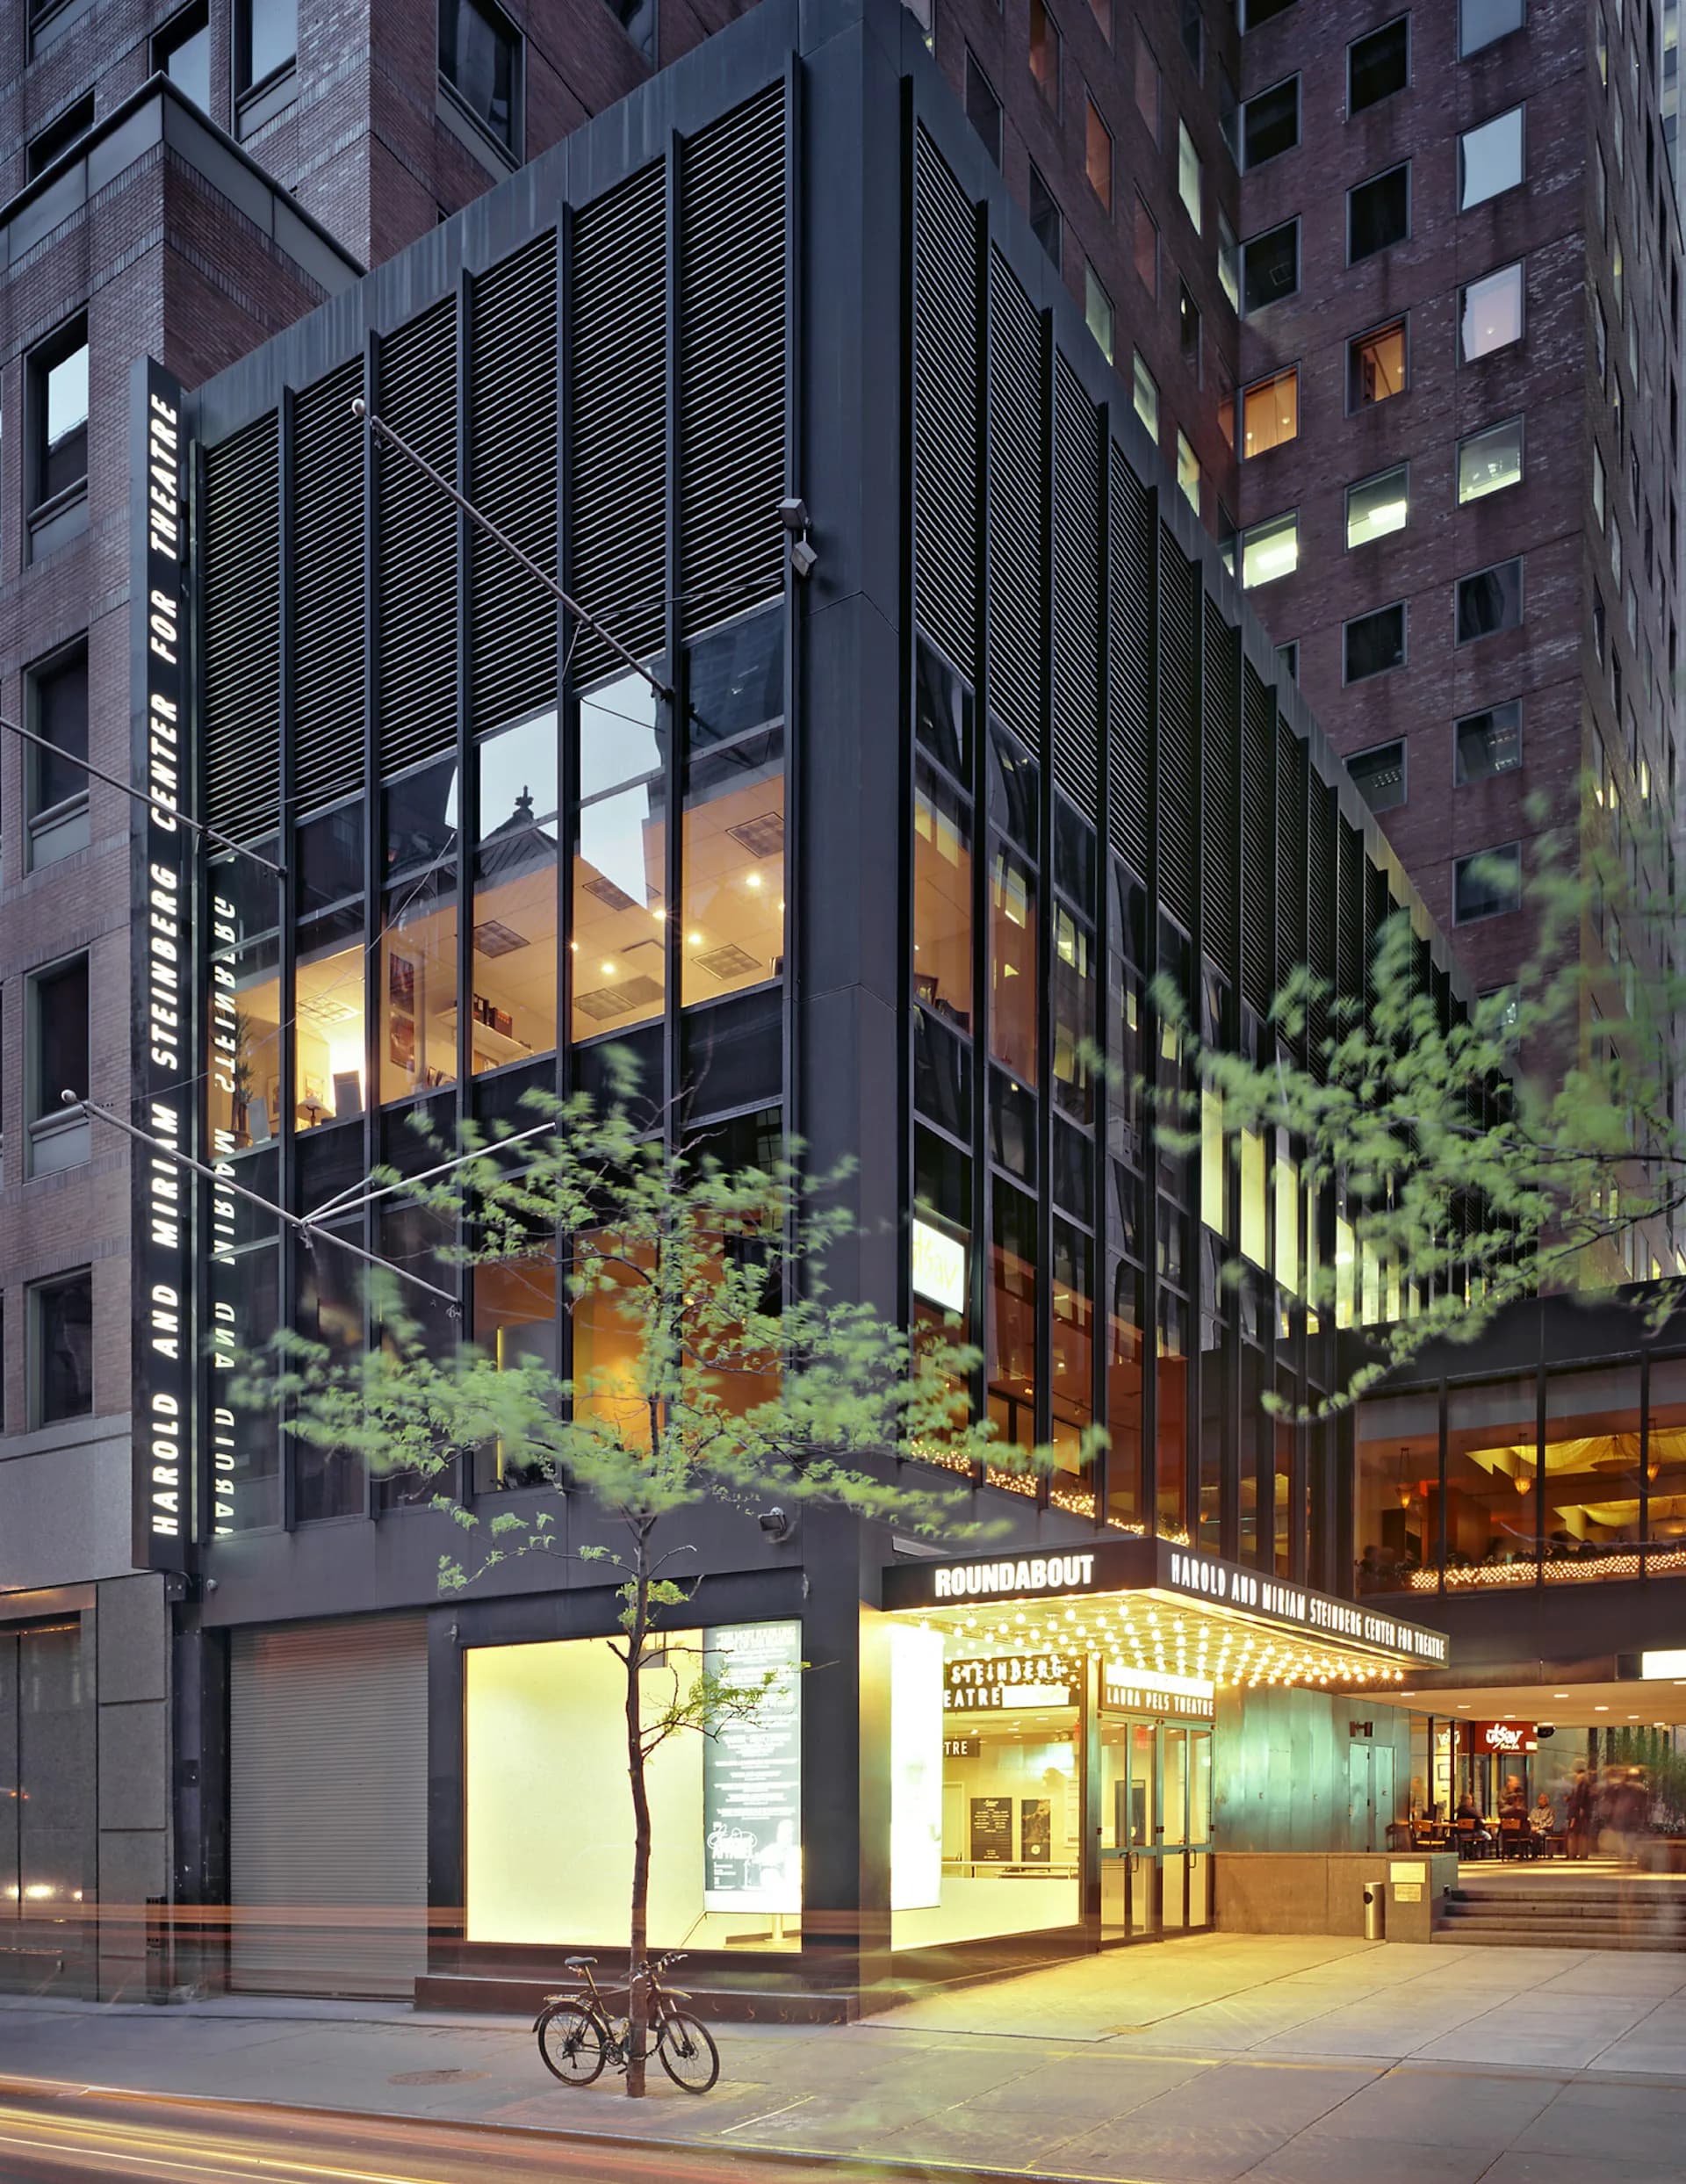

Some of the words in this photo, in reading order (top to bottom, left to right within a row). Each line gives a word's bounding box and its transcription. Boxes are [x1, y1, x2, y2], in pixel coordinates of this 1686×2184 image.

[150, 393, 177, 560] THEATRE
[150, 589, 177, 665] FOR
[150, 694, 177, 833] CENTER
[151, 862, 177, 1070] STEINBERG
[152, 1284, 178, 1359] AND
[152, 1393, 178, 1536] HAROLD
[934, 1554, 1094, 1597] ROUNDABOUT
[1171, 1553, 1226, 1597] HAROLD
[1231, 1573, 1257, 1606] AND
[1262, 1582, 1306, 1620] MIRIAM
[1309, 1597, 1362, 1637] STEINBERG
[1365, 1616, 1395, 1647] CENTER
[1398, 1625, 1413, 1652] FOR
[1415, 1631, 1445, 1660] THEATRE
[951, 1658, 1063, 1684] STEINBERG
[1106, 1686, 1141, 1707] LAURA
[1146, 1691, 1170, 1711] PELS
[1174, 1695, 1214, 1717] THEATRE
